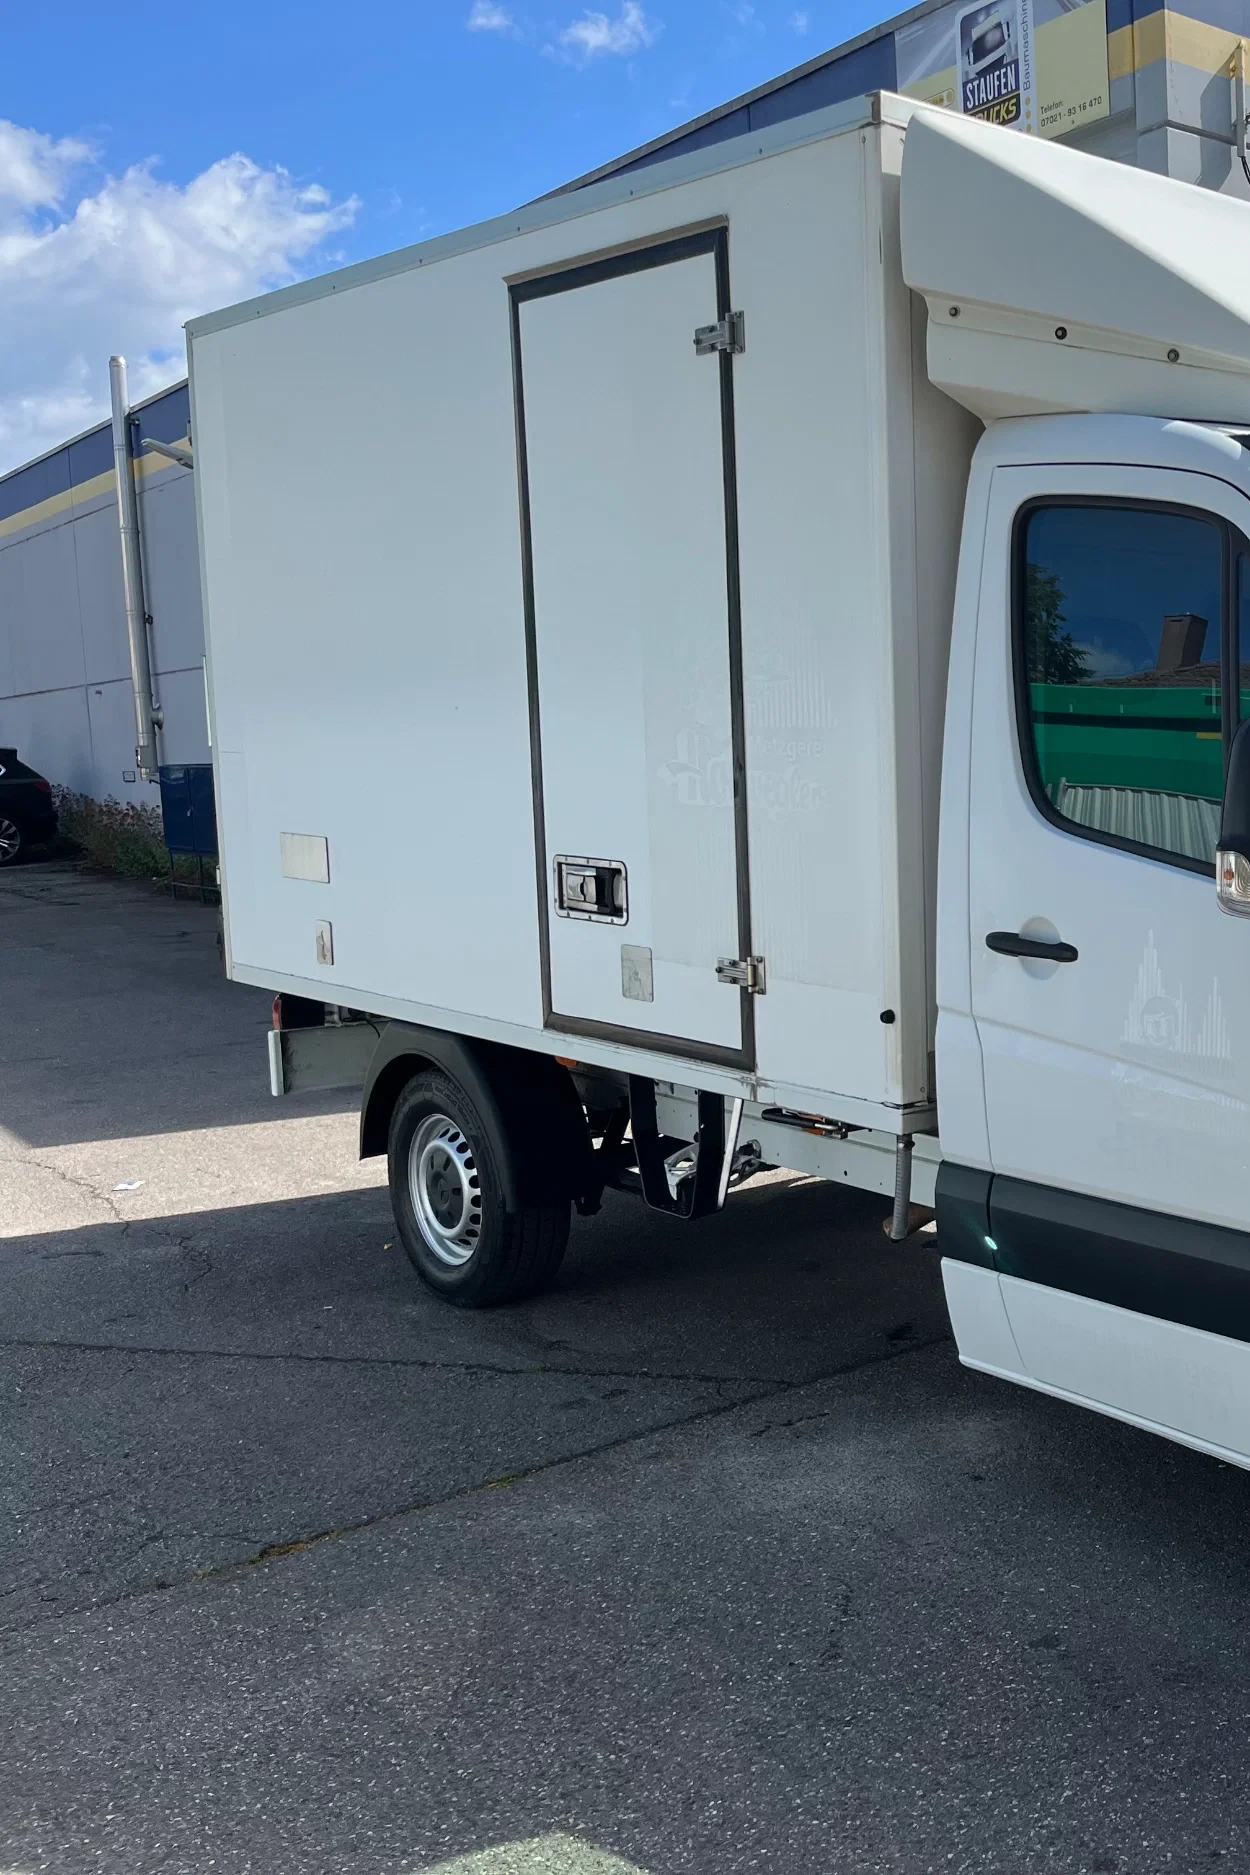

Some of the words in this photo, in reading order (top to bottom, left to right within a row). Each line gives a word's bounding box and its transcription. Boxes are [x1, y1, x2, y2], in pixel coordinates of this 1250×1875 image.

[966, 63, 1016, 109] STAUFEN
[1040, 111, 1062, 128] 07021
[1067, 106, 1077, 117] 93
[1078, 102, 1087, 112] 16
[1088, 95, 1102, 108] 470
